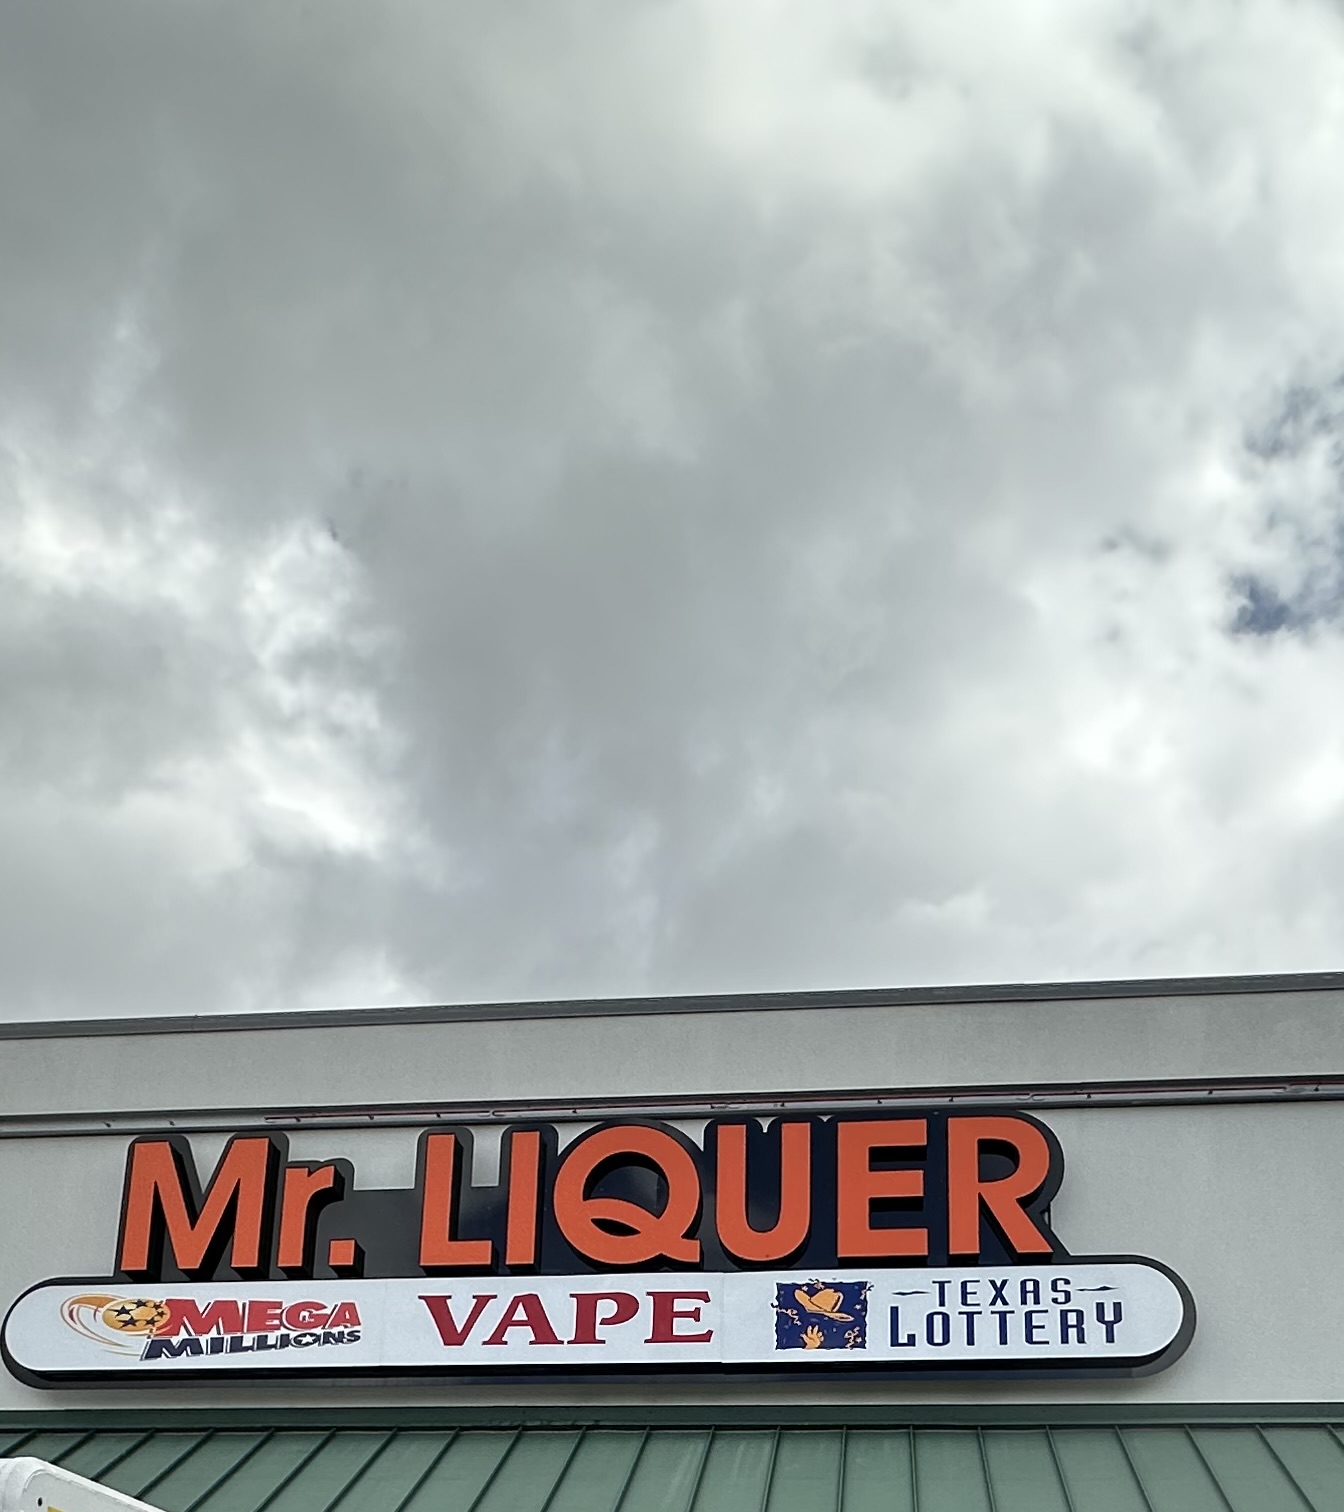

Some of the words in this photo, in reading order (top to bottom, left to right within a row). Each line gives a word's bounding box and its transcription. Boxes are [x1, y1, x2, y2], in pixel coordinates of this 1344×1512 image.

[120, 1135, 358, 1271] Mr.
[419, 1115, 1056, 1269] LIQUER
[931, 1278, 1072, 1307] TEXAS
[154, 1298, 362, 1339] MEGA
[418, 1291, 714, 1348] VAPE
[889, 1301, 1124, 1348] LOTTERY
[140, 1329, 362, 1361] MILLIONS
